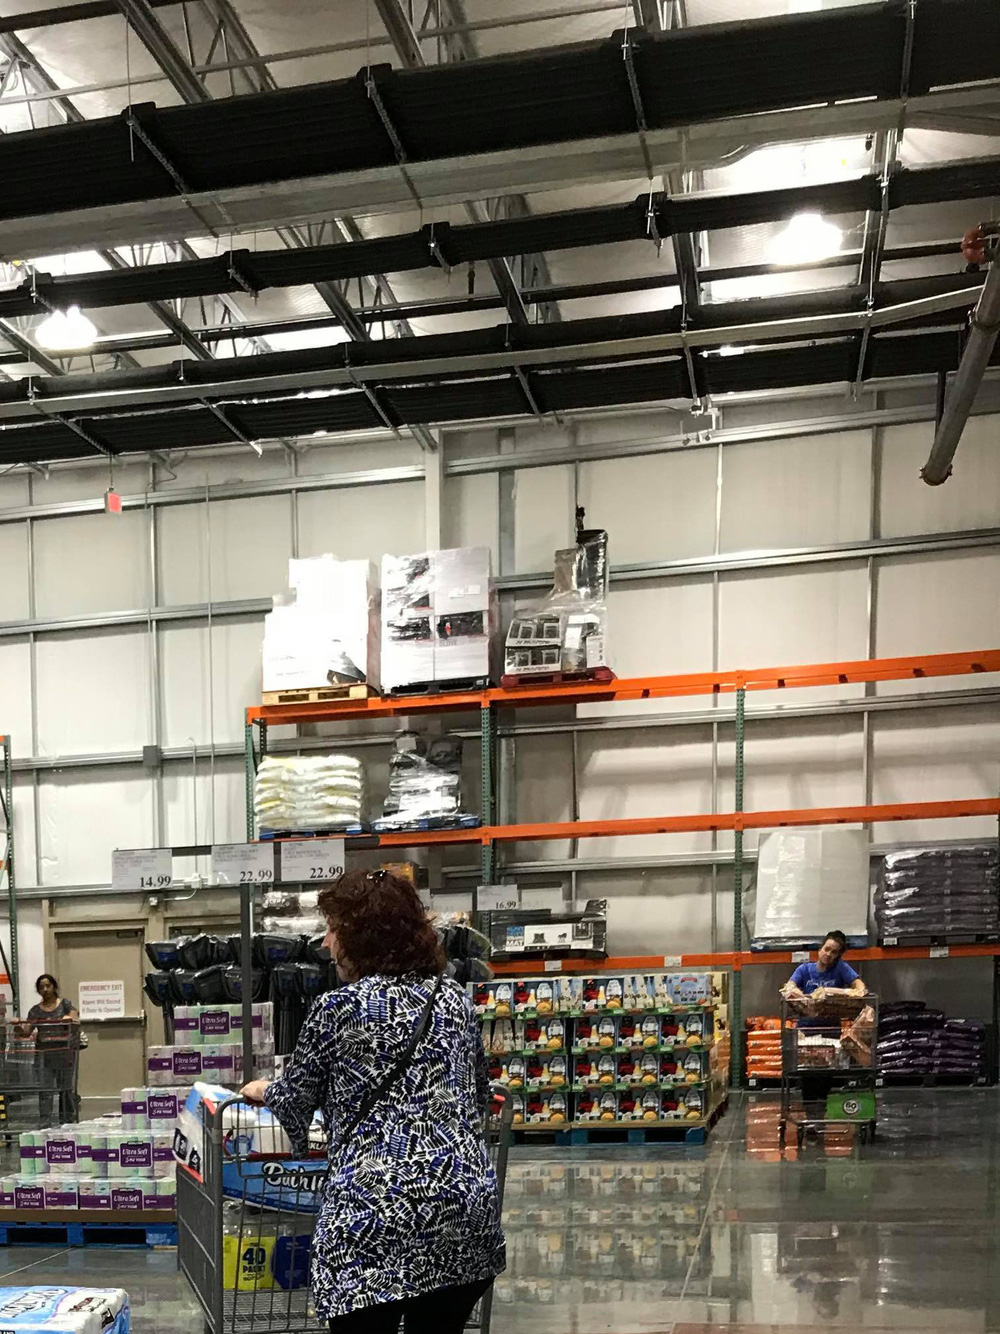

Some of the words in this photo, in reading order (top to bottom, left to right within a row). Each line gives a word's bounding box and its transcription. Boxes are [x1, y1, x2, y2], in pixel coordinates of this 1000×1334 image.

[239, 869, 273, 882] 22.99
[310, 866, 343, 879] 22.99
[139, 876, 171, 888] 14.99
[495, 901, 517, 910] 16.99
[242, 1248, 266, 1265] 40
